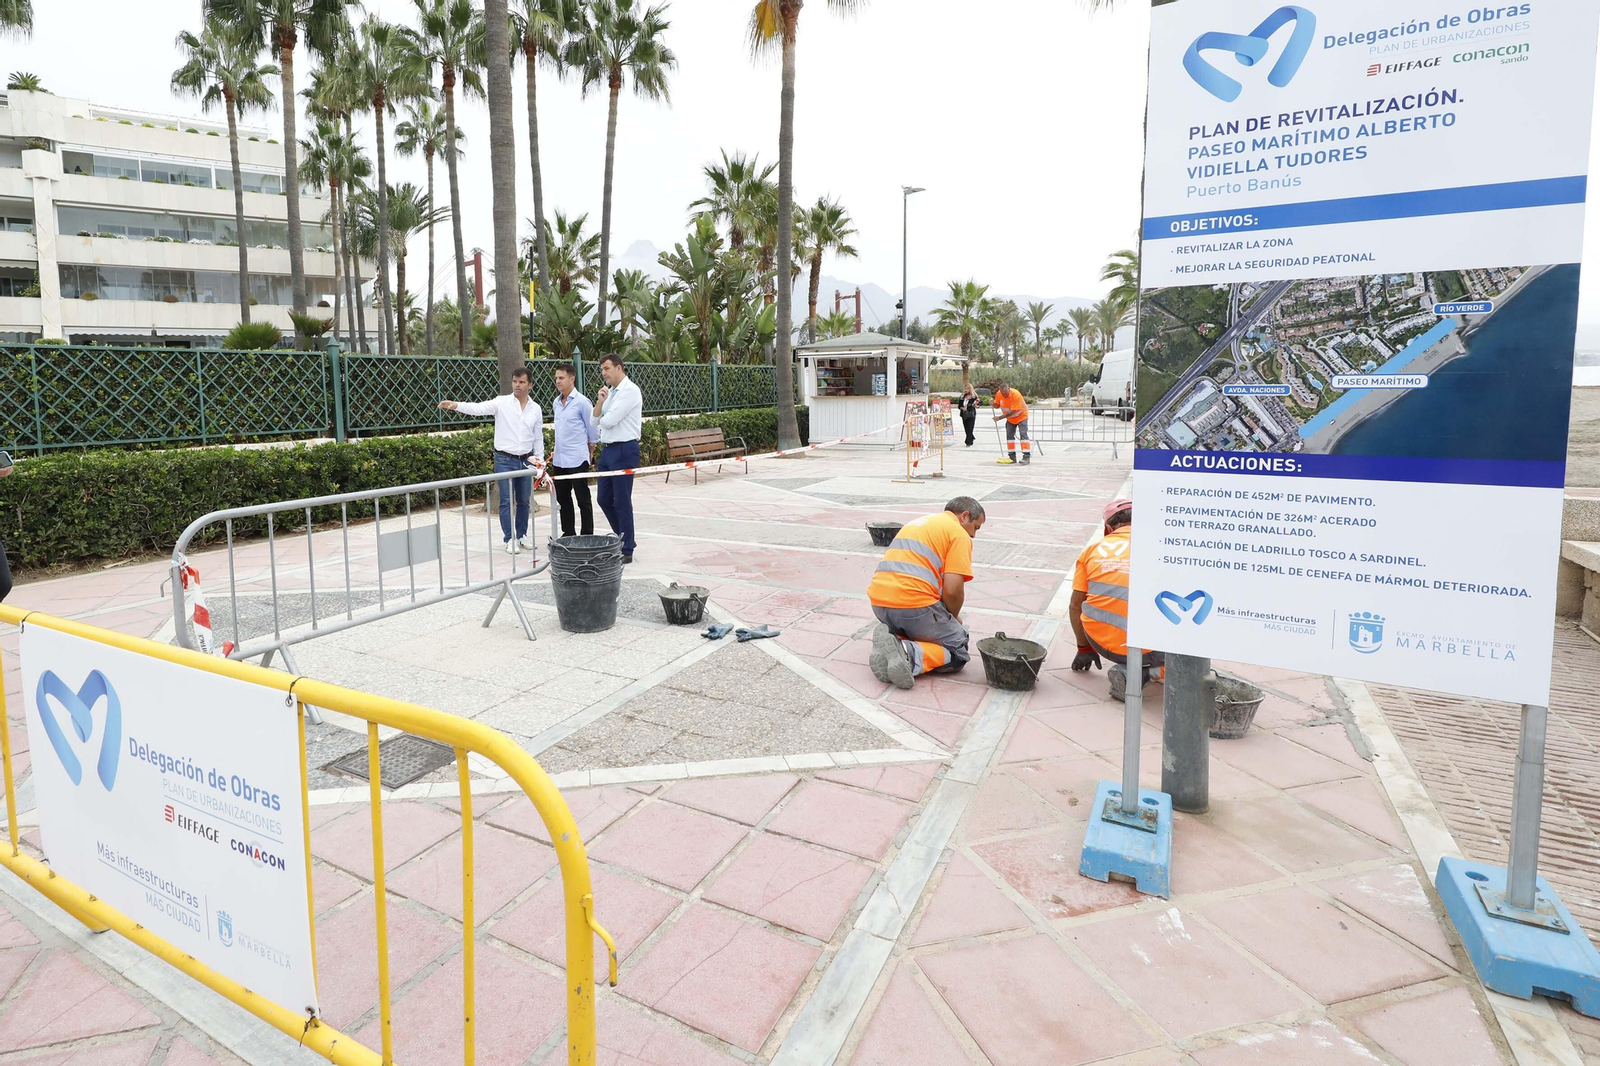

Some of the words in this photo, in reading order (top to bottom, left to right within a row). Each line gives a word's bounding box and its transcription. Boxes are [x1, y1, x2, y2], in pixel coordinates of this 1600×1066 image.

[1324, 19, 1430, 49] Delegación
[1436, 15, 1461, 29] de
[1467, 3, 1531, 24] Obras
[1369, 43, 1400, 55] PLAN
[1403, 40, 1418, 49] DE
[1422, 21, 1530, 47] URBANIZACIONES
[1453, 43, 1530, 63] conacon
[1500, 55, 1529, 65] sando
[1385, 56, 1442, 74] EIFFAGE
[1189, 120, 1240, 140] PLAN
[1246, 116, 1271, 133] DE
[1278, 87, 1464, 128] REVITALIZACIÓN.
[1188, 140, 1246, 160] PASEO
[1252, 126, 1350, 152] MARÍTIMO
[1356, 112, 1456, 138] ALBERTO
[1187, 158, 1269, 180] VIDIELLA
[1275, 145, 1368, 169] TUDORES
[1187, 182, 1242, 198] Puerto
[1248, 174, 1302, 191] Banús
[1170, 214, 1259, 233] OBJETIVOS:
[1177, 241, 1243, 254] REVITALIZAR
[1246, 240, 1260, 249] LA
[1263, 238, 1293, 248] ZONA
[1175, 262, 1225, 274] MEJORAR
[1228, 261, 1242, 271] LA
[1244, 257, 1310, 269] SEGURIDAD
[1313, 252, 1376, 265] PEATONAL
[1440, 303, 1454, 313] RÍO
[1456, 304, 1485, 312] VERDE
[1228, 386, 1248, 394] AVDA.
[1250, 386, 1285, 394] NACIONES
[1337, 378, 1370, 386] PASEO
[1372, 376, 1421, 386] MARÍTIMO
[1170, 454, 1302, 472] ACTUACIONES:
[1166, 487, 1232, 499] REPARACIÓN
[1235, 491, 1249, 500] DE
[1287, 493, 1302, 502] DE
[1305, 494, 1376, 507] PAVIMENTO.
[1165, 505, 1263, 521] REPAVIMENTACIÓN
[1266, 512, 1281, 521] DE
[1320, 516, 1377, 527] ACERADO
[1164, 518, 1185, 528] CON
[1188, 520, 1235, 532] TERRAZO
[1238, 524, 1317, 538] GRANALLADO.
[1164, 537, 1231, 550] INSTALACIÓN
[1234, 543, 1248, 551] DE
[1251, 544, 1305, 557] LADRILLO
[1308, 549, 1346, 560] TOSCO
[1349, 552, 1357, 561] A
[1360, 553, 1426, 567] SARDINEL.
[1163, 555, 1231, 569] SUSTITUCIÓN
[1233, 562, 1248, 571] DE
[1251, 564, 1285, 575] 125ML
[1288, 568, 1303, 576] DE
[1306, 569, 1352, 581] CENEFA
[1355, 573, 1371, 582] DE
[1374, 574, 1430, 588] MÁRMOL
[1433, 580, 1532, 598] DETERIORADA.
[1217, 606, 1236, 615] Más
[1238, 609, 1316, 625] infraestructuras
[1264, 623, 1282, 631] MÁS
[1284, 625, 1316, 635] CIUDAD
[1396, 637, 1515, 662] MARBELLA
[1432, 635, 1501, 648] AYUNTAMIENTO
[129, 736, 204, 784] Delegación
[208, 768, 227, 792] de
[231, 775, 281, 812] Obras
[162, 778, 185, 797] PLAN
[186, 788, 198, 802] DE
[200, 793, 283, 835] URBANIZACIONES
[178, 814, 220, 844] EIFFAGE
[230, 839, 285, 871] CONACON
[96, 841, 115, 863] Más
[117, 852, 199, 909] infraestructuras
[146, 892, 164, 912] MÁS
[166, 903, 201, 933] CIUDAD
[238, 936, 292, 970] MARBELLA
